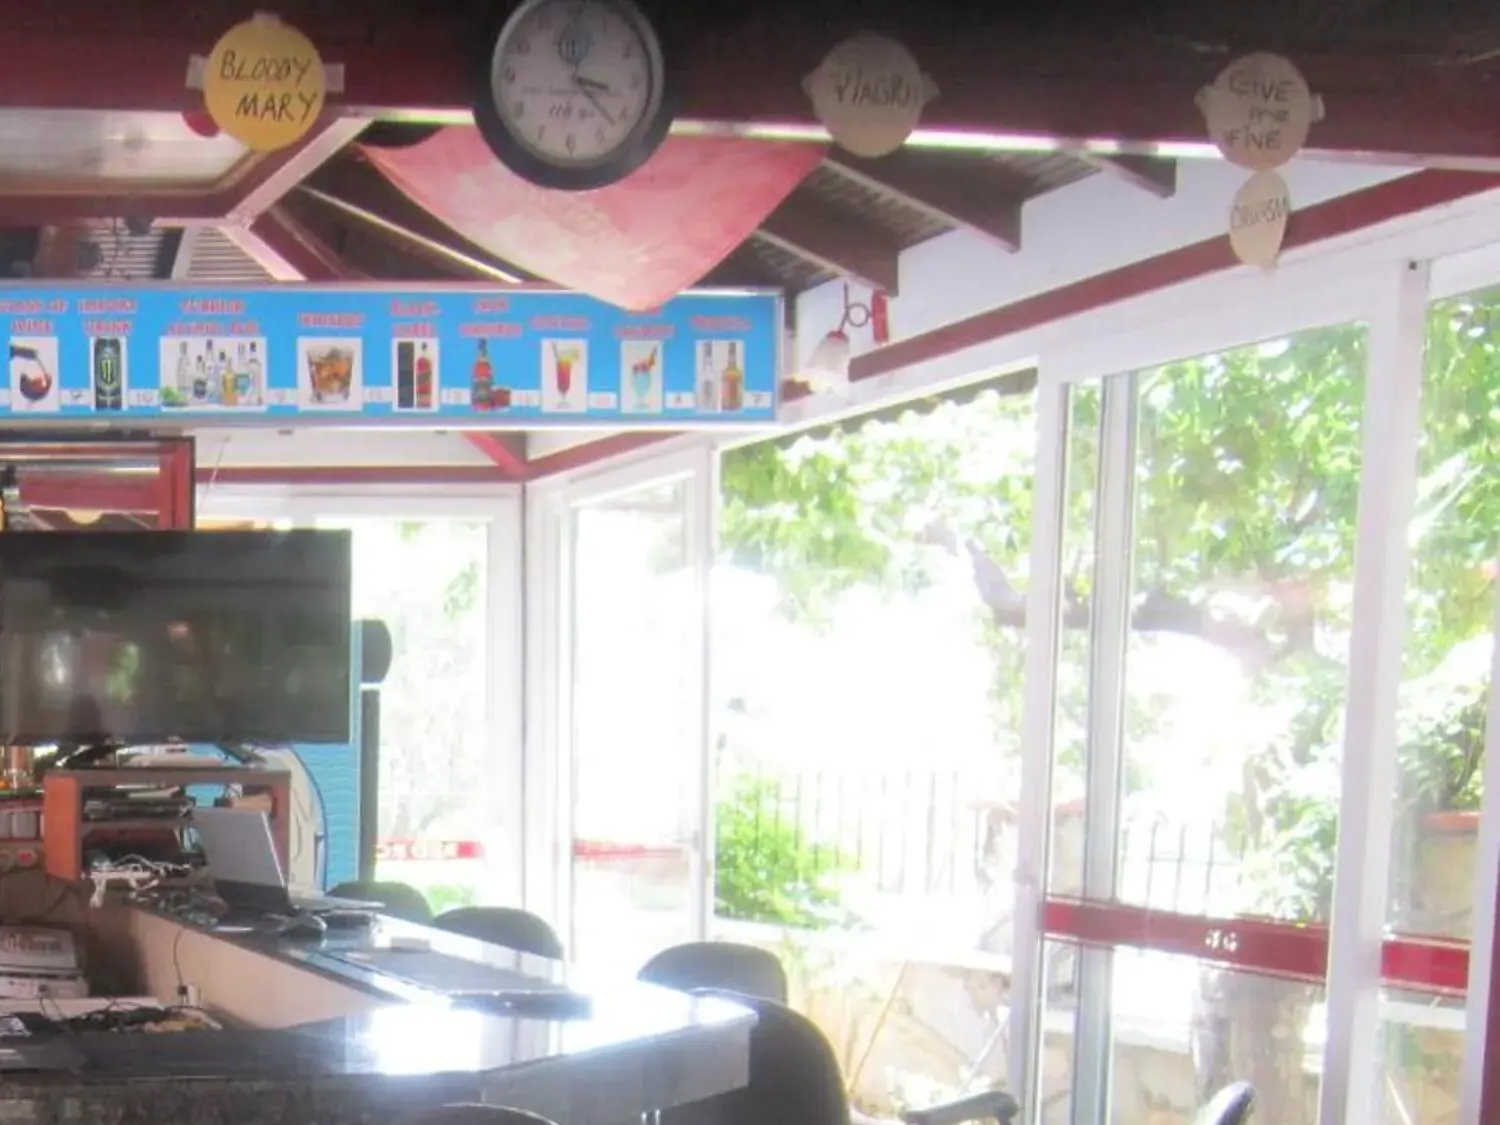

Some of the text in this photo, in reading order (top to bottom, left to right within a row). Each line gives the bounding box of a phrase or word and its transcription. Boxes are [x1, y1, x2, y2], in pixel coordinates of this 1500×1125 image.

[220, 49, 312, 87] BLOODY
[1228, 70, 1296, 104] GIVE
[235, 92, 317, 127] MARY
